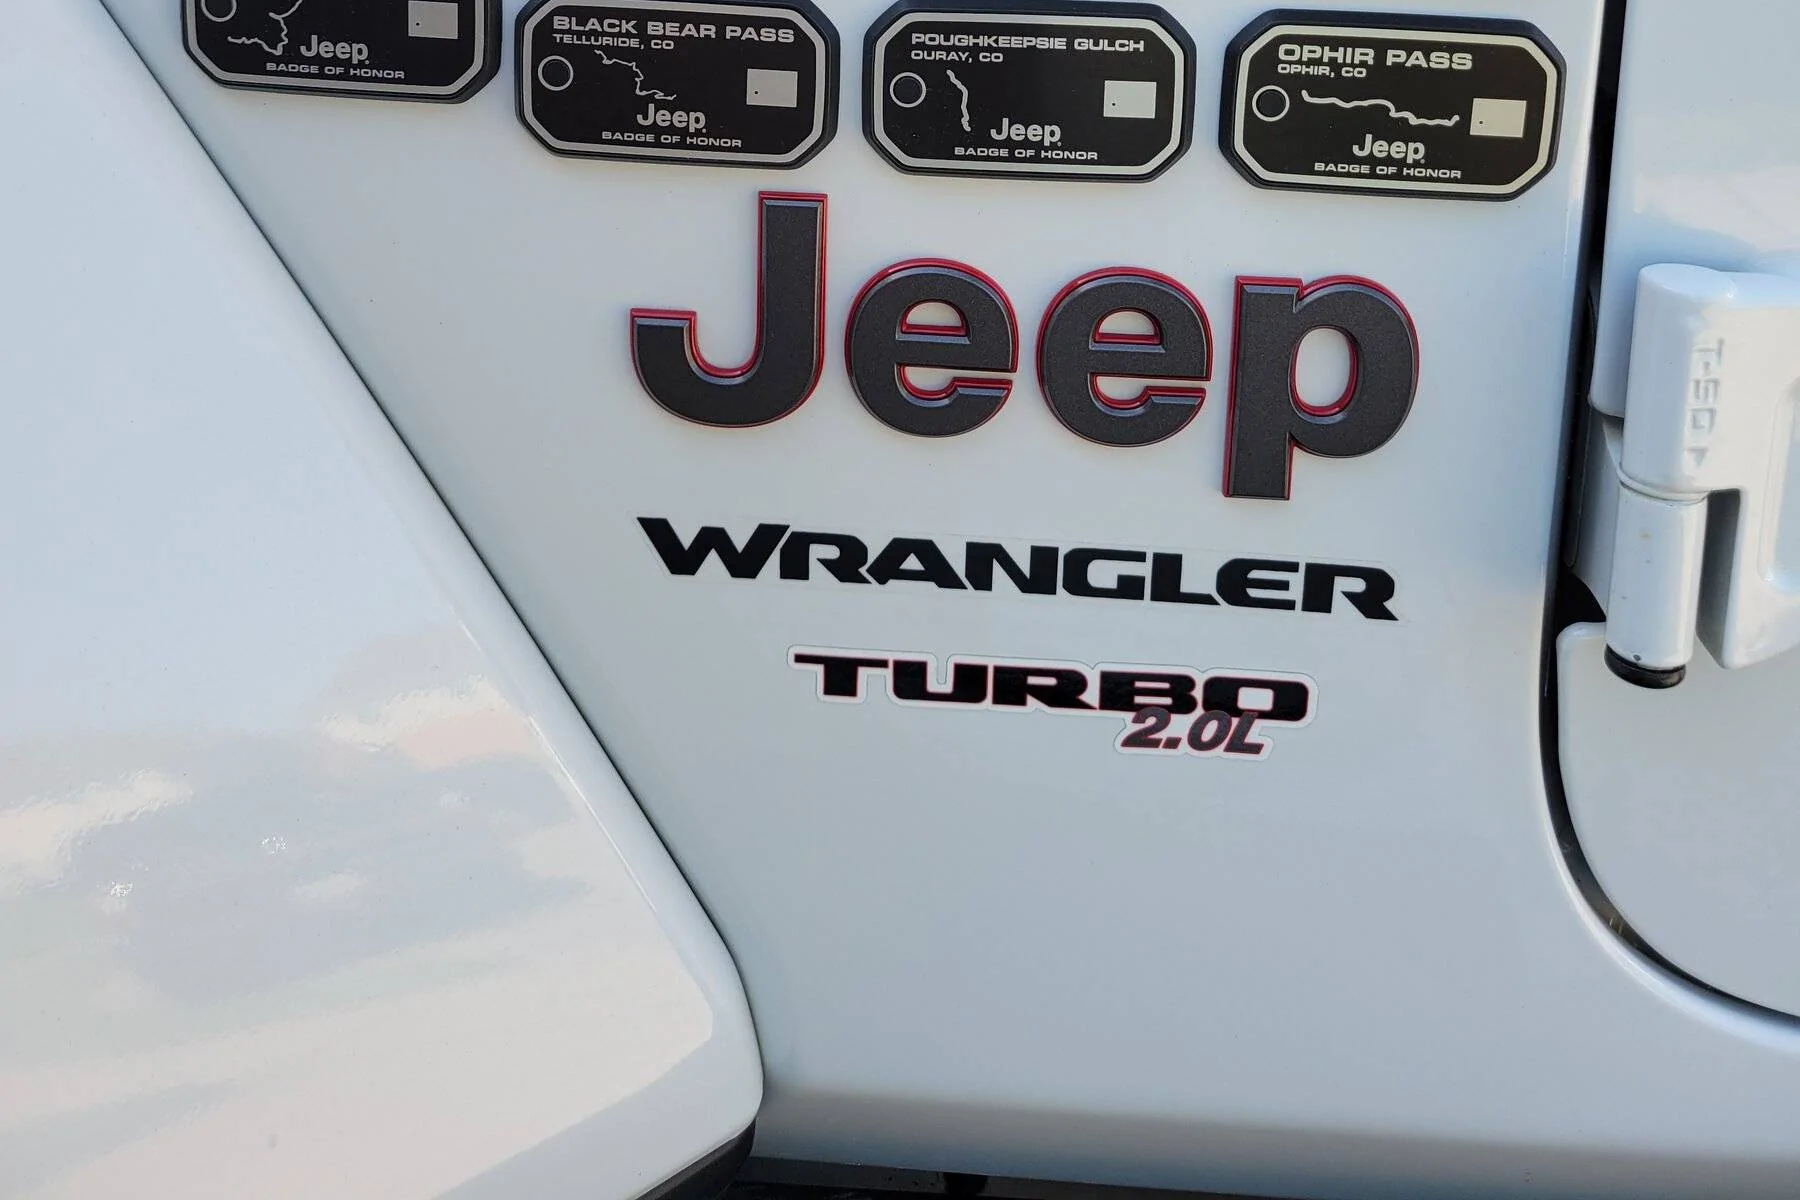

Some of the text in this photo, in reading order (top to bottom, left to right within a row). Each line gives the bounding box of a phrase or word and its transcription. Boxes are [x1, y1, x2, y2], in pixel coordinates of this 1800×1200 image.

[552, 16, 794, 43] BLACK BEAR PASS
[552, 34, 674, 50] TELLURIDE, CO
[912, 33, 1144, 52] POUGHKEEPSIE GULCH
[300, 35, 368, 64] Jeep
[911, 50, 1003, 63] OURAY, CO
[1277, 44, 1472, 70] OPHIR PASS
[266, 63, 405, 79] BADGE OF HONOR
[1277, 64, 1367, 78] OPHIR, CO
[637, 103, 706, 133] Jeep
[602, 131, 742, 147] BADGE OF HONOR
[990, 118, 1061, 146] Jeep
[955, 147, 1098, 160] BADGE OF HONOR
[1352, 134, 1425, 164] Jeep
[1314, 162, 1461, 179] BADGE OF HONOR
[630, 191, 1420, 501] Jeep
[636, 517, 1400, 622] WRANGLER
[793, 653, 1310, 723] TURBO
[1120, 708, 1267, 757] 2.0L
